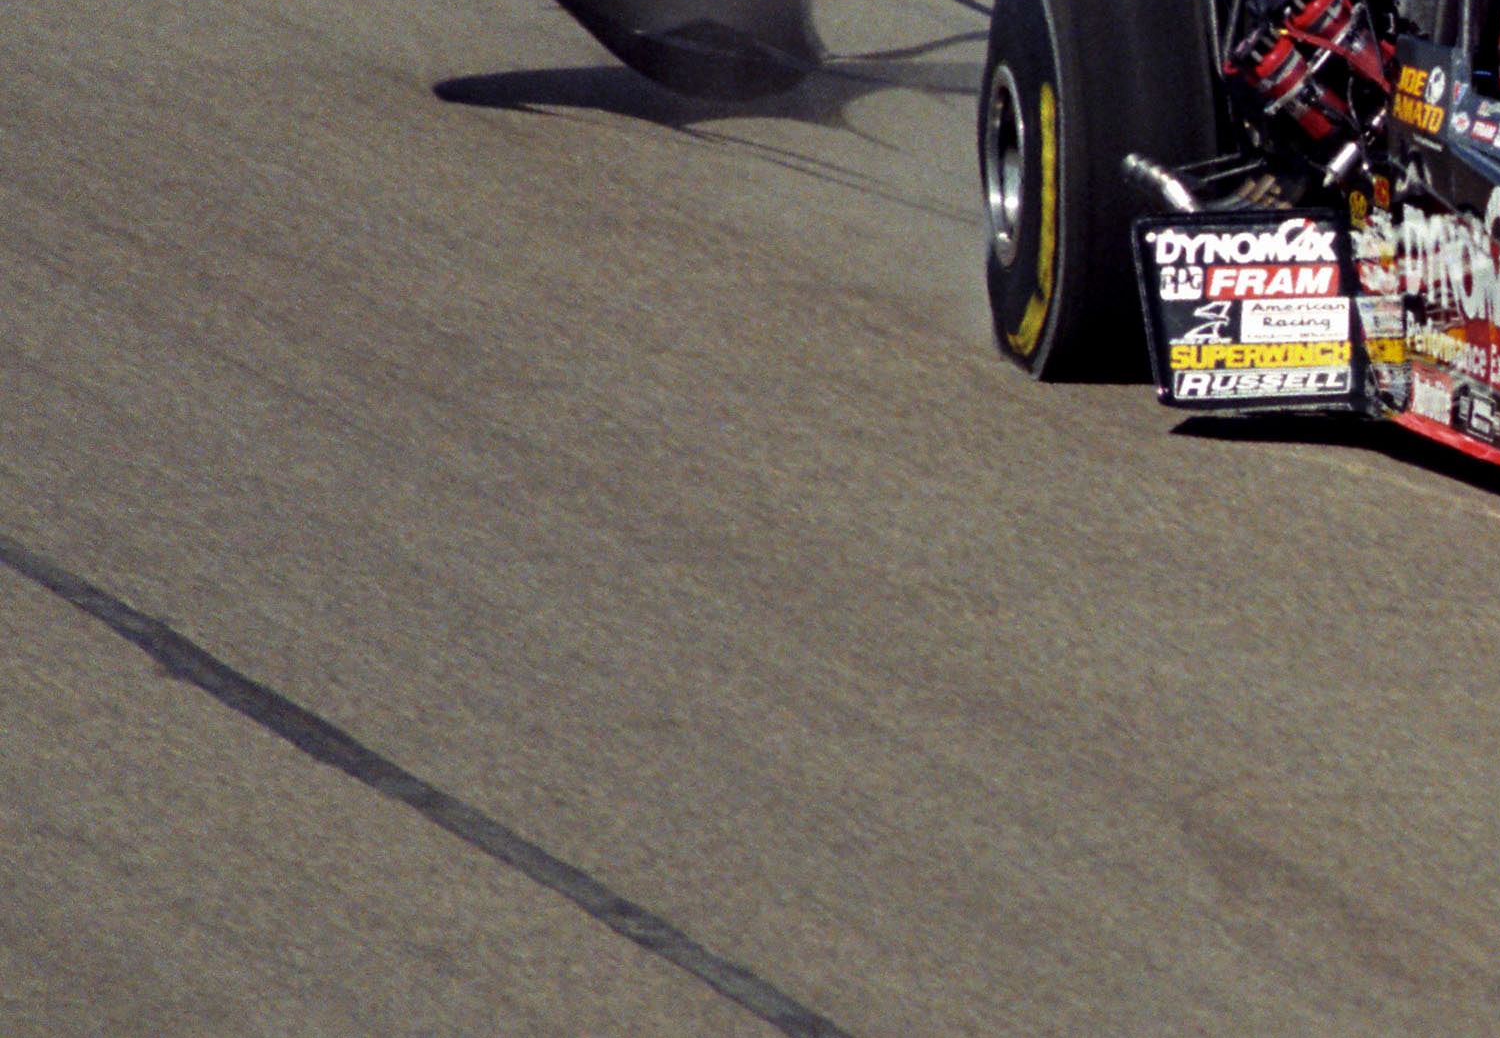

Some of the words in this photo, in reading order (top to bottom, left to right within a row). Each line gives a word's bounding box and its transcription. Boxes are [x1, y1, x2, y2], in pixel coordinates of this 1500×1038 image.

[1398, 66, 1428, 97] JOE
[1394, 93, 1445, 136] AMATO
[1155, 218, 1337, 264] DYNOMAX
[1209, 267, 1334, 297] FRAM
[1251, 303, 1346, 313] American
[1263, 316, 1331, 330] Racing
[1170, 341, 1352, 370] SUPERWINCH
[1179, 371, 1347, 397] RUSSELL
